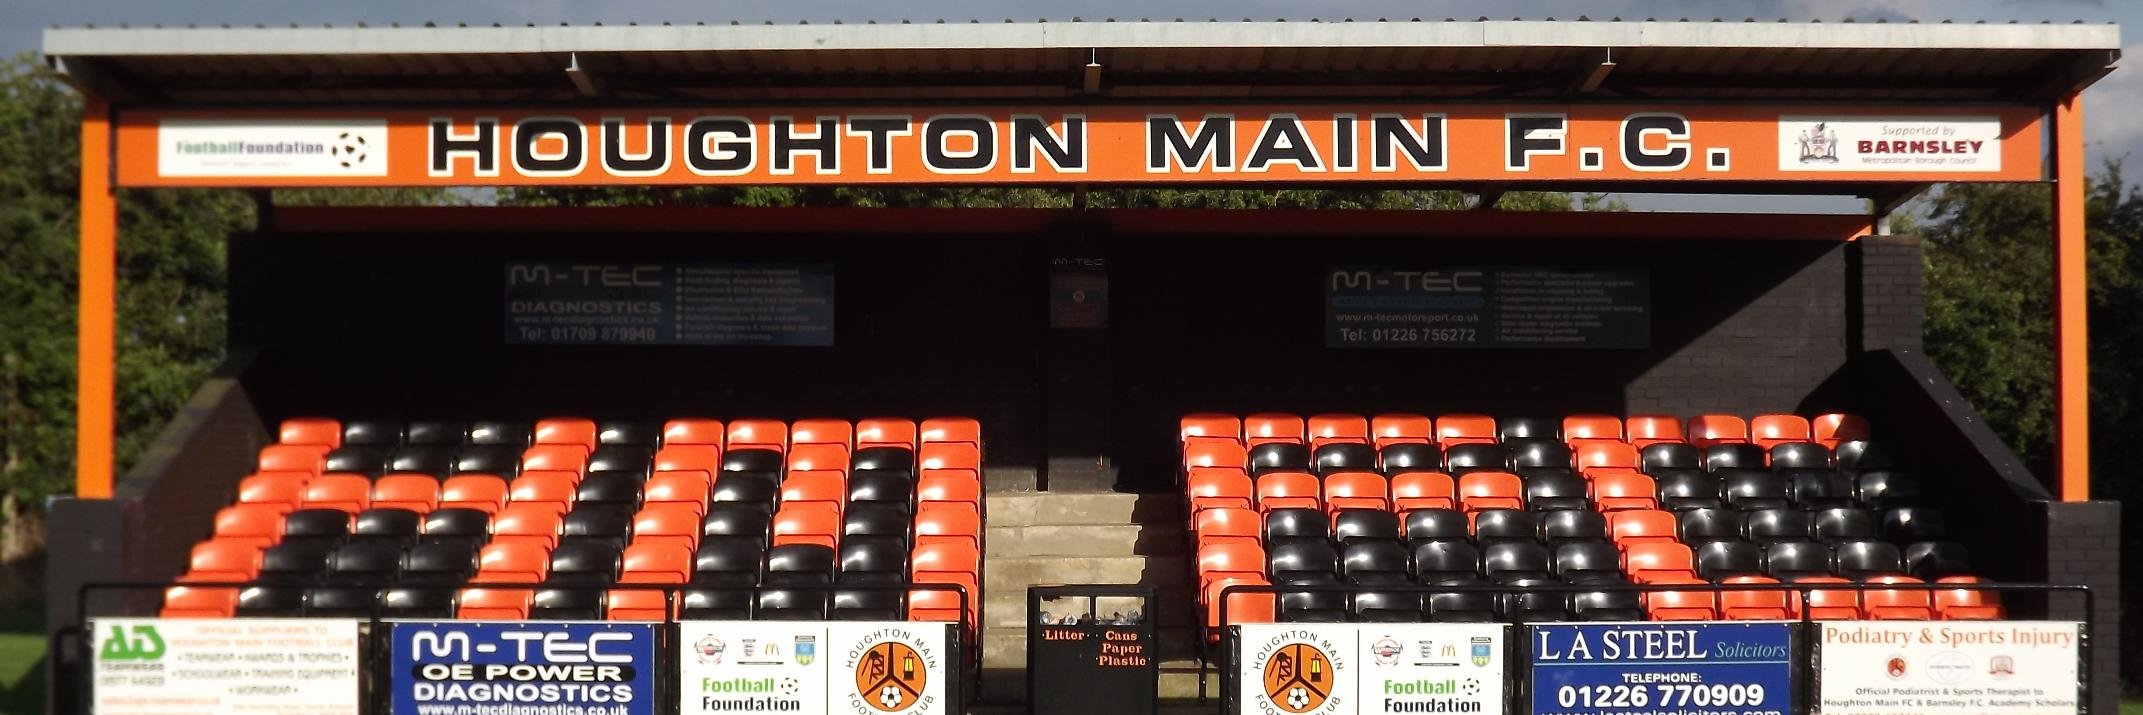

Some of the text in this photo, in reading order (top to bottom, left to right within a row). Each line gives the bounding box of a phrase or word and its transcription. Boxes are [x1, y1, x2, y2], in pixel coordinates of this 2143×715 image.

[1882, 126, 1957, 137] Supported by
[428, 111, 1731, 178] HOUGHTON MAIN F.C.
[1857, 140, 1984, 154] BARNSLEY
[1861, 157, 1911, 165] Metropolitan
[511, 265, 663, 287] M-TEC
[1333, 271, 1483, 292] M-TEC
[511, 301, 663, 314] DIAGNOSTICS
[1335, 313, 1480, 323] www.m-tecmotorsport.co.uk
[520, 327, 656, 341] Tel: 01709 879940
[1340, 328, 1477, 341] Tel: 01226 756272
[1045, 629, 1085, 641] Litter
[1105, 630, 1138, 641] Cans
[1826, 627, 2075, 649] Podiatry & Sports Injury
[413, 631, 633, 663] M-TEC
[846, 629, 937, 669] HOUGHTON MAIN
[1102, 642, 1143, 656] Paper
[1253, 630, 1345, 670] HOUGHTON MAIN
[1538, 630, 1787, 660] L A STEEL Solicitors
[1098, 655, 1147, 666] Plastic
[423, 664, 623, 682] OE POWER
[1621, 672, 1702, 683] TELEPHONE:
[702, 677, 774, 692] Football
[1384, 679, 1455, 694] Football
[414, 683, 633, 703] DIAGNOSTICS
[1558, 684, 1764, 708] 01226 770909
[1952, 688, 1983, 696] Sports
[1986, 688, 2031, 696] Therapist
[418, 703, 629, 715] www.m-tecdiagnostics.co.uk
[702, 696, 800, 711] Foundation
[1384, 698, 1481, 712] Foundation
[1824, 699, 1872, 708] Houghton
[1926, 699, 1966, 708] Barnsley
[1988, 699, 2031, 708] Academy
